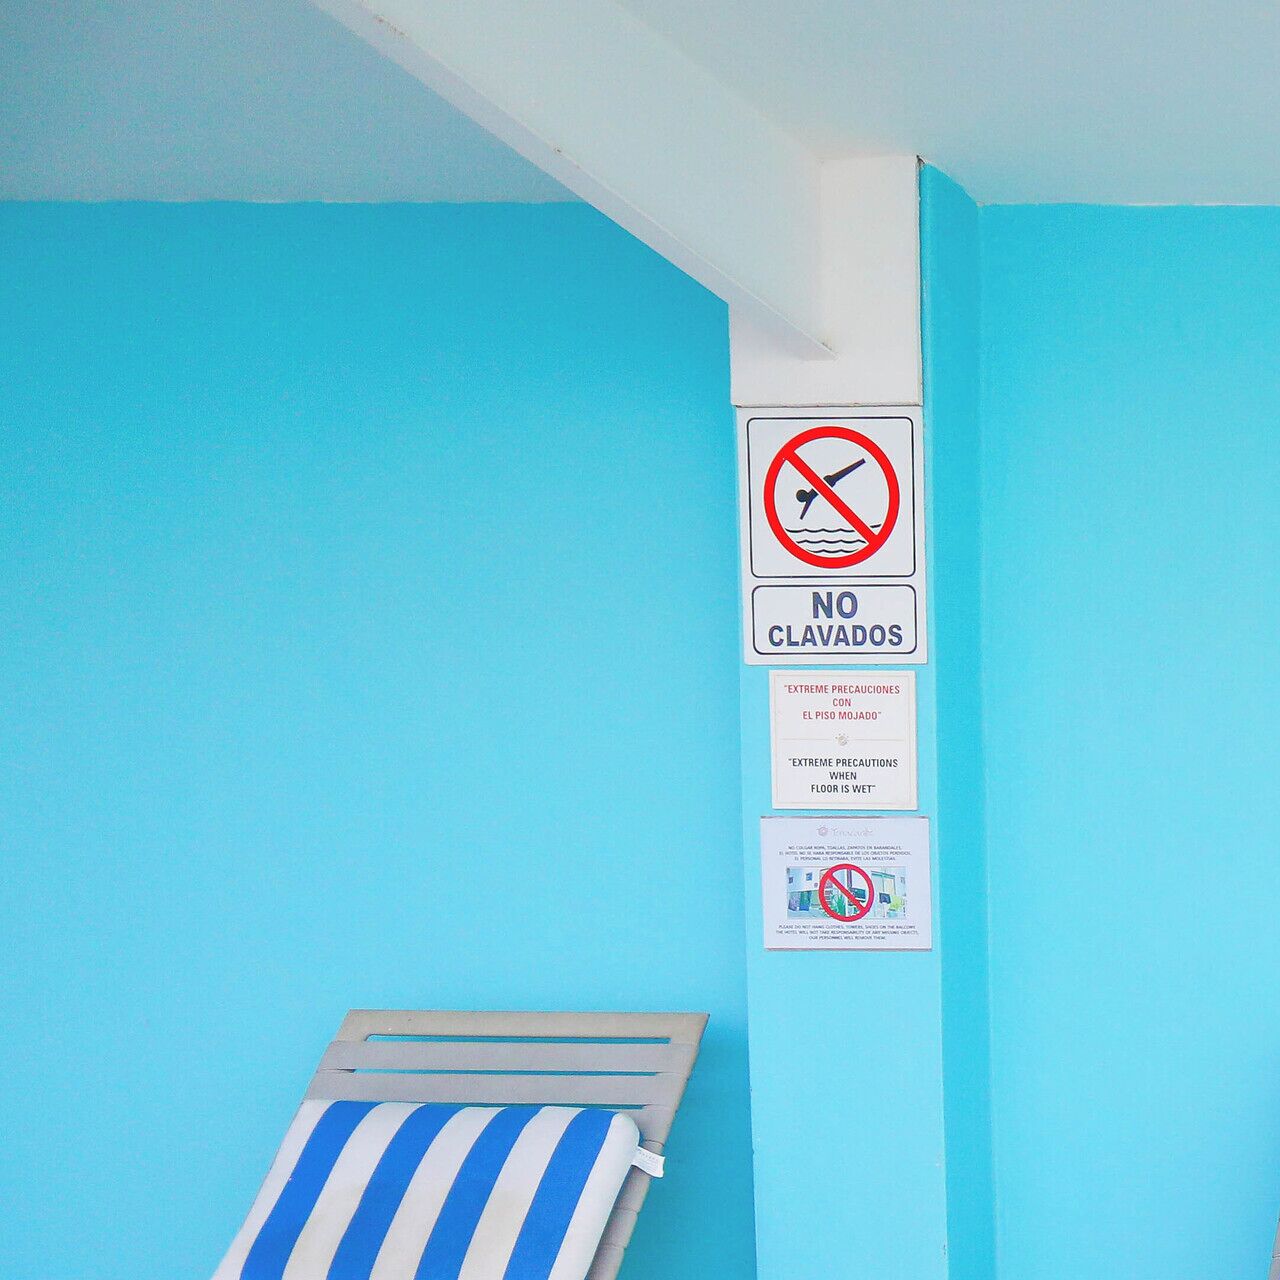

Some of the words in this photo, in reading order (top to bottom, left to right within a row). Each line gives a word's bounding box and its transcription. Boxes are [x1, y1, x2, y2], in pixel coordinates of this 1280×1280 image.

[812, 591, 858, 619] NO
[768, 624, 903, 647] CLAVADOS
[832, 685, 900, 695] PRECAUCIONES
[832, 698, 851, 707] CON
[803, 711, 813, 720] EL
[815, 711, 836, 720] PISO
[836, 758, 898, 768] PRECAUTIONS
[829, 771, 857, 780] WHEN
[811, 784, 838, 793] FLOOR
[841, 784, 850, 793] IS
